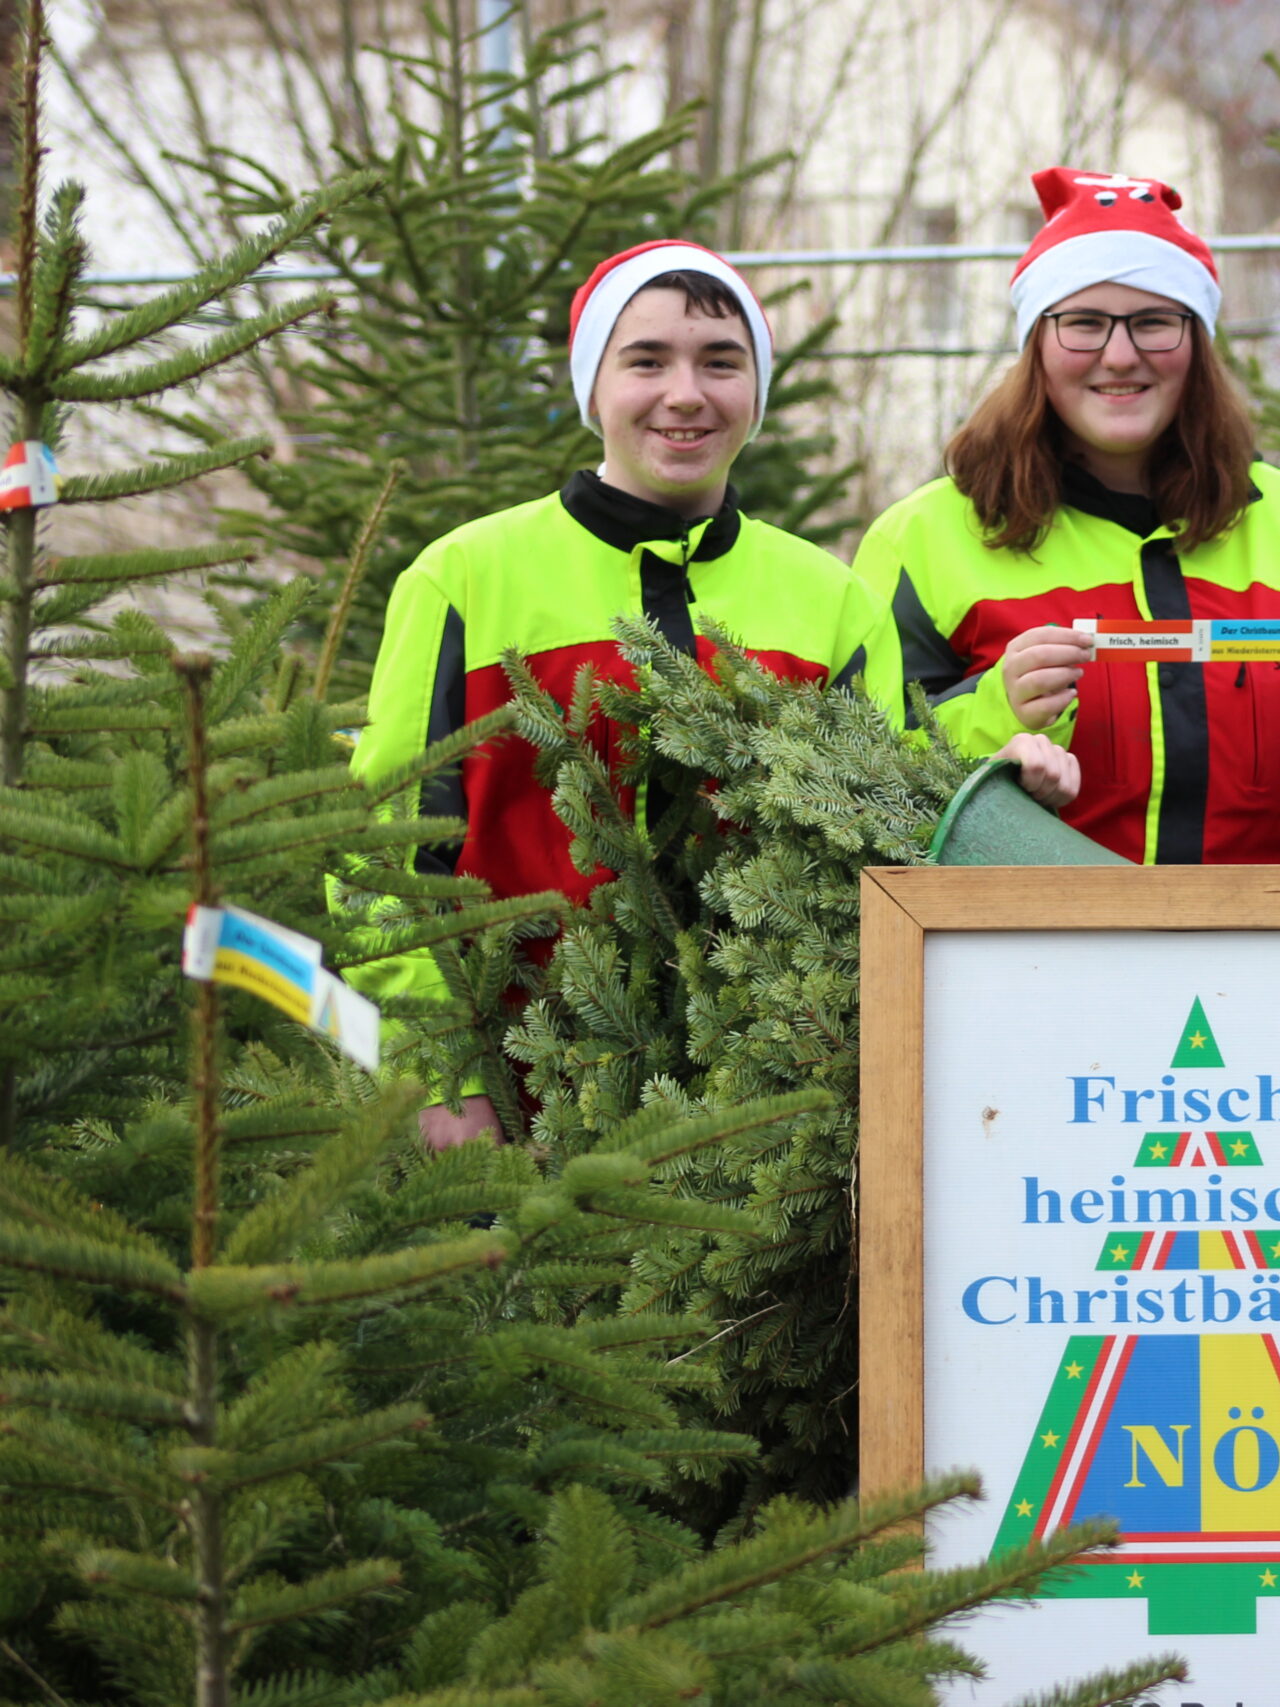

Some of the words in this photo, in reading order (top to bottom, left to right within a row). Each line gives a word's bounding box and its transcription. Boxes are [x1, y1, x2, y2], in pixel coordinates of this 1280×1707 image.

[1220, 626, 1238, 635] Der
[1109, 636, 1136, 647] frisch,
[1139, 636, 1179, 646] heimisch
[1121, 1406, 1280, 1492] NÖ
